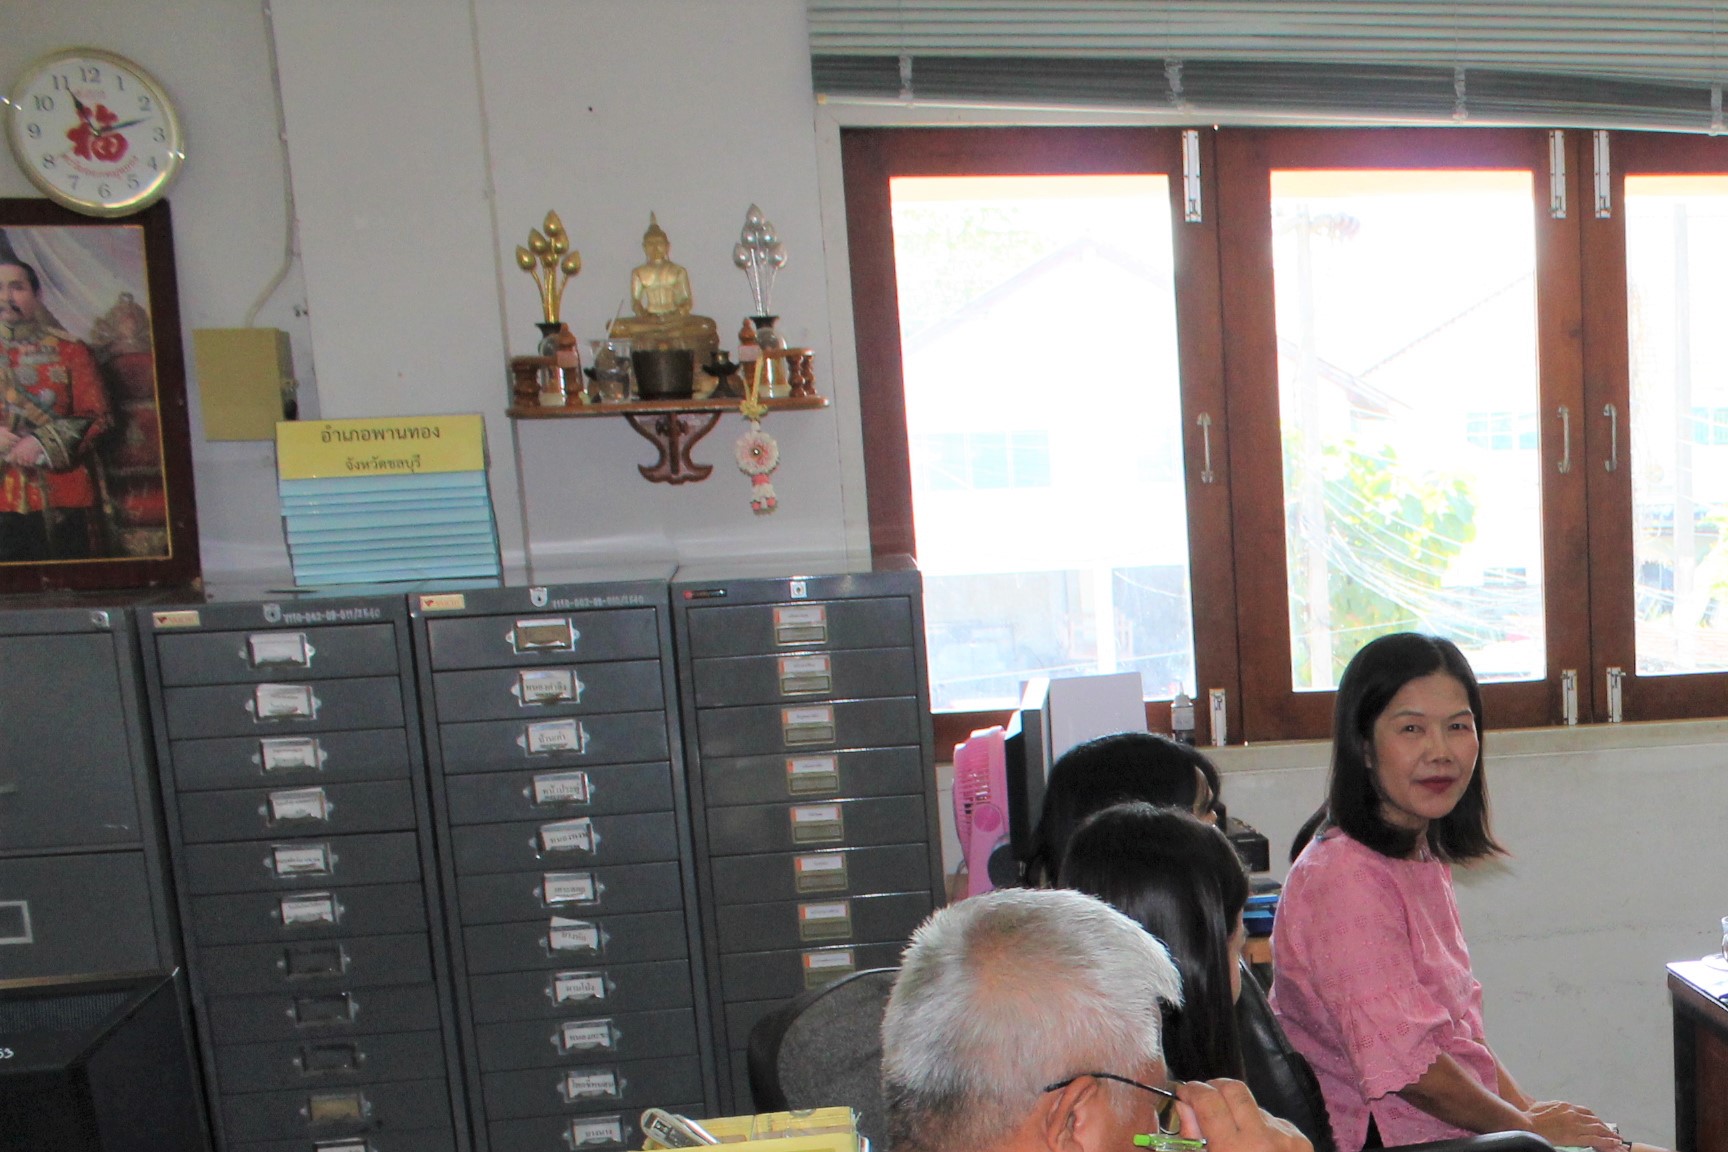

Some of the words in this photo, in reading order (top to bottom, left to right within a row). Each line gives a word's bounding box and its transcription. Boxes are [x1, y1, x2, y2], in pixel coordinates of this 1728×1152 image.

[52, 74, 69, 90] 11
[80, 66, 100, 83] 12
[116, 75, 125, 92] 1
[33, 95, 54, 112] 10
[138, 95, 151, 112] 2
[27, 123, 41, 139] 9
[152, 127, 166, 143] 3
[43, 154, 56, 170] 8
[147, 156, 158, 171] 4
[69, 174, 80, 190] 7
[127, 174, 140, 190] 5
[98, 184, 112, 199] 6
[320, 424, 441, 443] อำเภอพานทอง
[345, 454, 421, 473] จังหวัดชลบุรี
